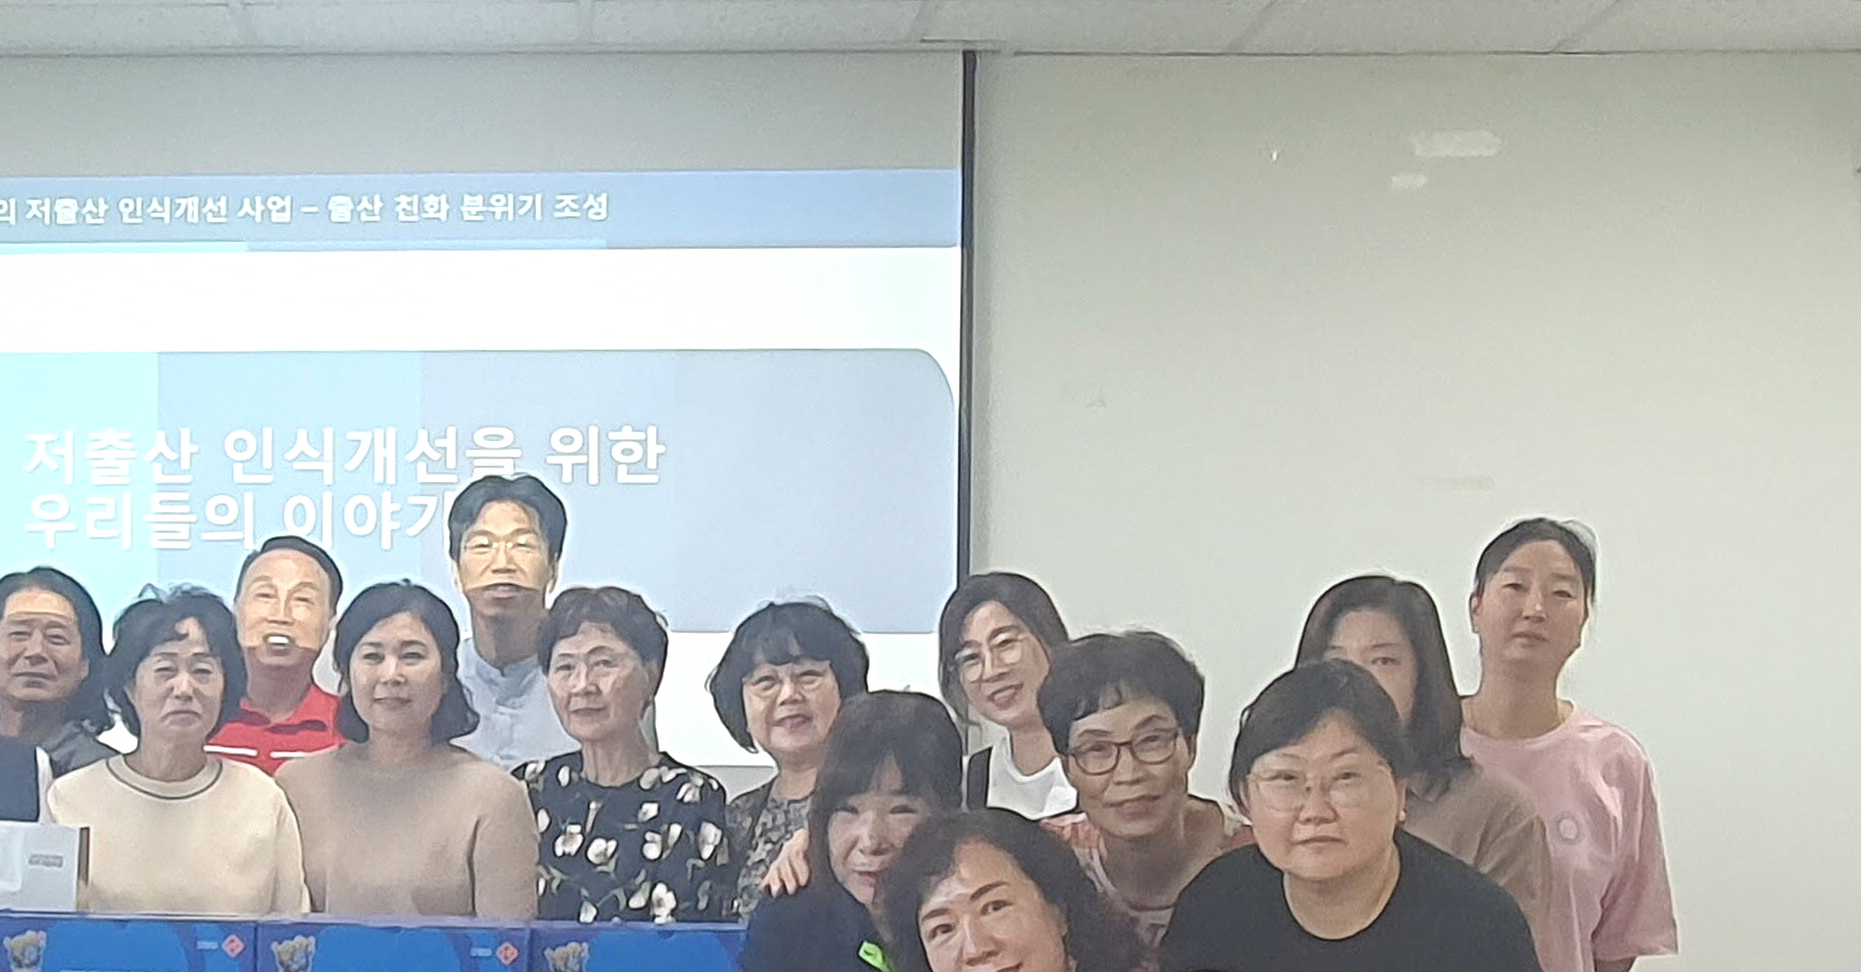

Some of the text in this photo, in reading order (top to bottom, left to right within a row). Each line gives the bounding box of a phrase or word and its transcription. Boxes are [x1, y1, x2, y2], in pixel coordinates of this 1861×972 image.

[25, 197, 109, 226] 저출산
[118, 196, 228, 224] 인식개선
[238, 195, 293, 223] 사업
[394, 193, 450, 222] 친화
[460, 193, 543, 222] 분위기
[553, 192, 610, 221] 조성
[23, 425, 666, 485] 저출산 인식개선을 위한
[23, 491, 256, 549] 우리들의
